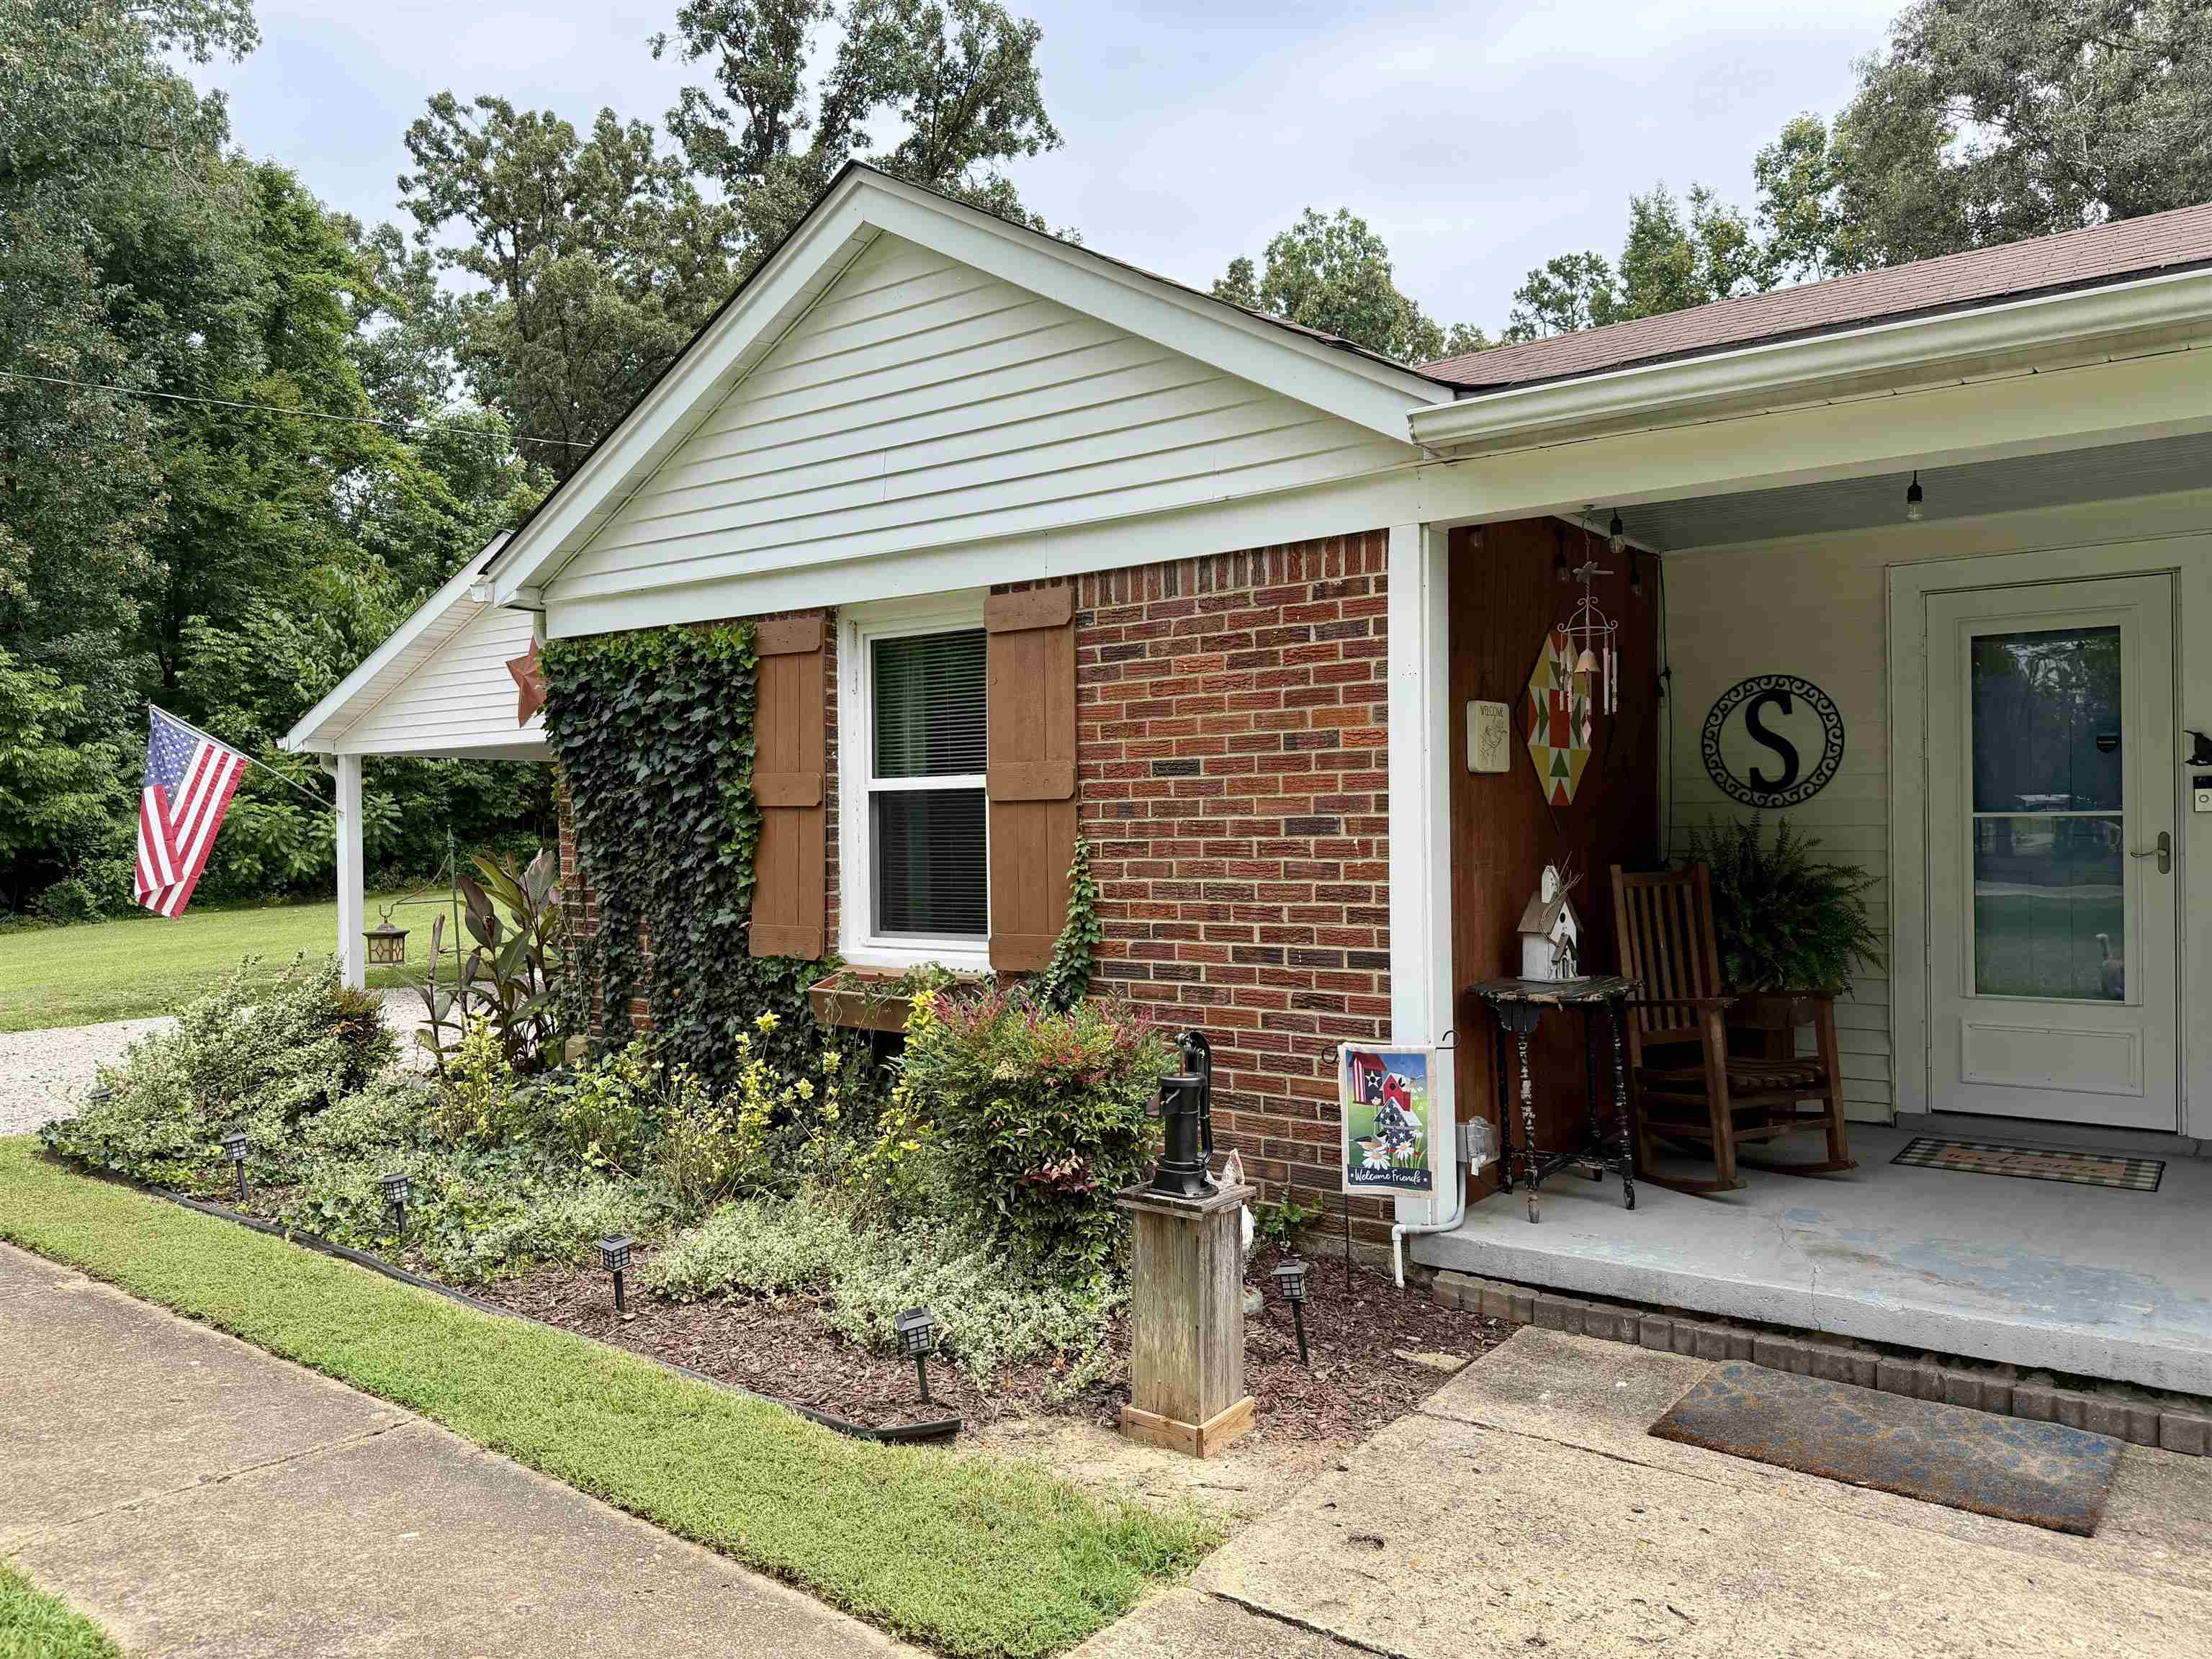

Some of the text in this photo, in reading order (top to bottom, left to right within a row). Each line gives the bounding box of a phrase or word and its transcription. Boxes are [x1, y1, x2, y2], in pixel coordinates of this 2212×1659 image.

[1480, 705, 1503, 717] WELCOME
[1745, 689, 1799, 792] S
[1946, 1151, 2106, 1174] welcome
[1354, 1168, 1422, 1185] Welcome Friends
